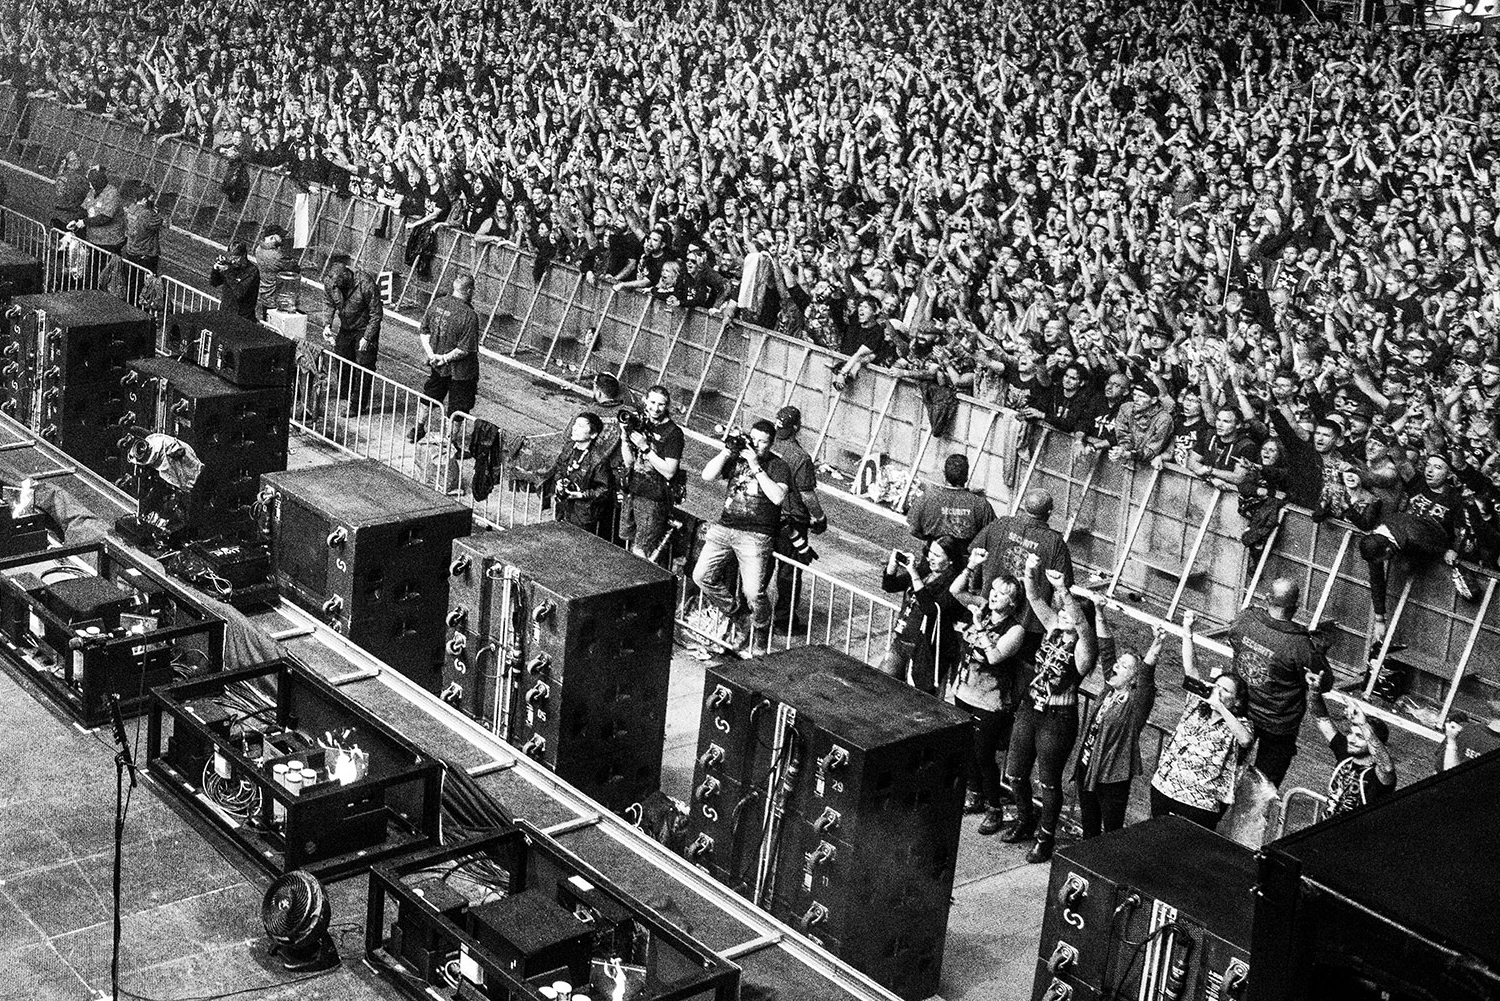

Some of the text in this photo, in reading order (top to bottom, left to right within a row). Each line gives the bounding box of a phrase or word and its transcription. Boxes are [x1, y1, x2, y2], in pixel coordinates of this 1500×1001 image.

[941, 506, 971, 517] SECURITY
[1008, 531, 1040, 550] SECURITY
[1241, 635, 1276, 659] SECURITY
[831, 779, 844, 793] 29
